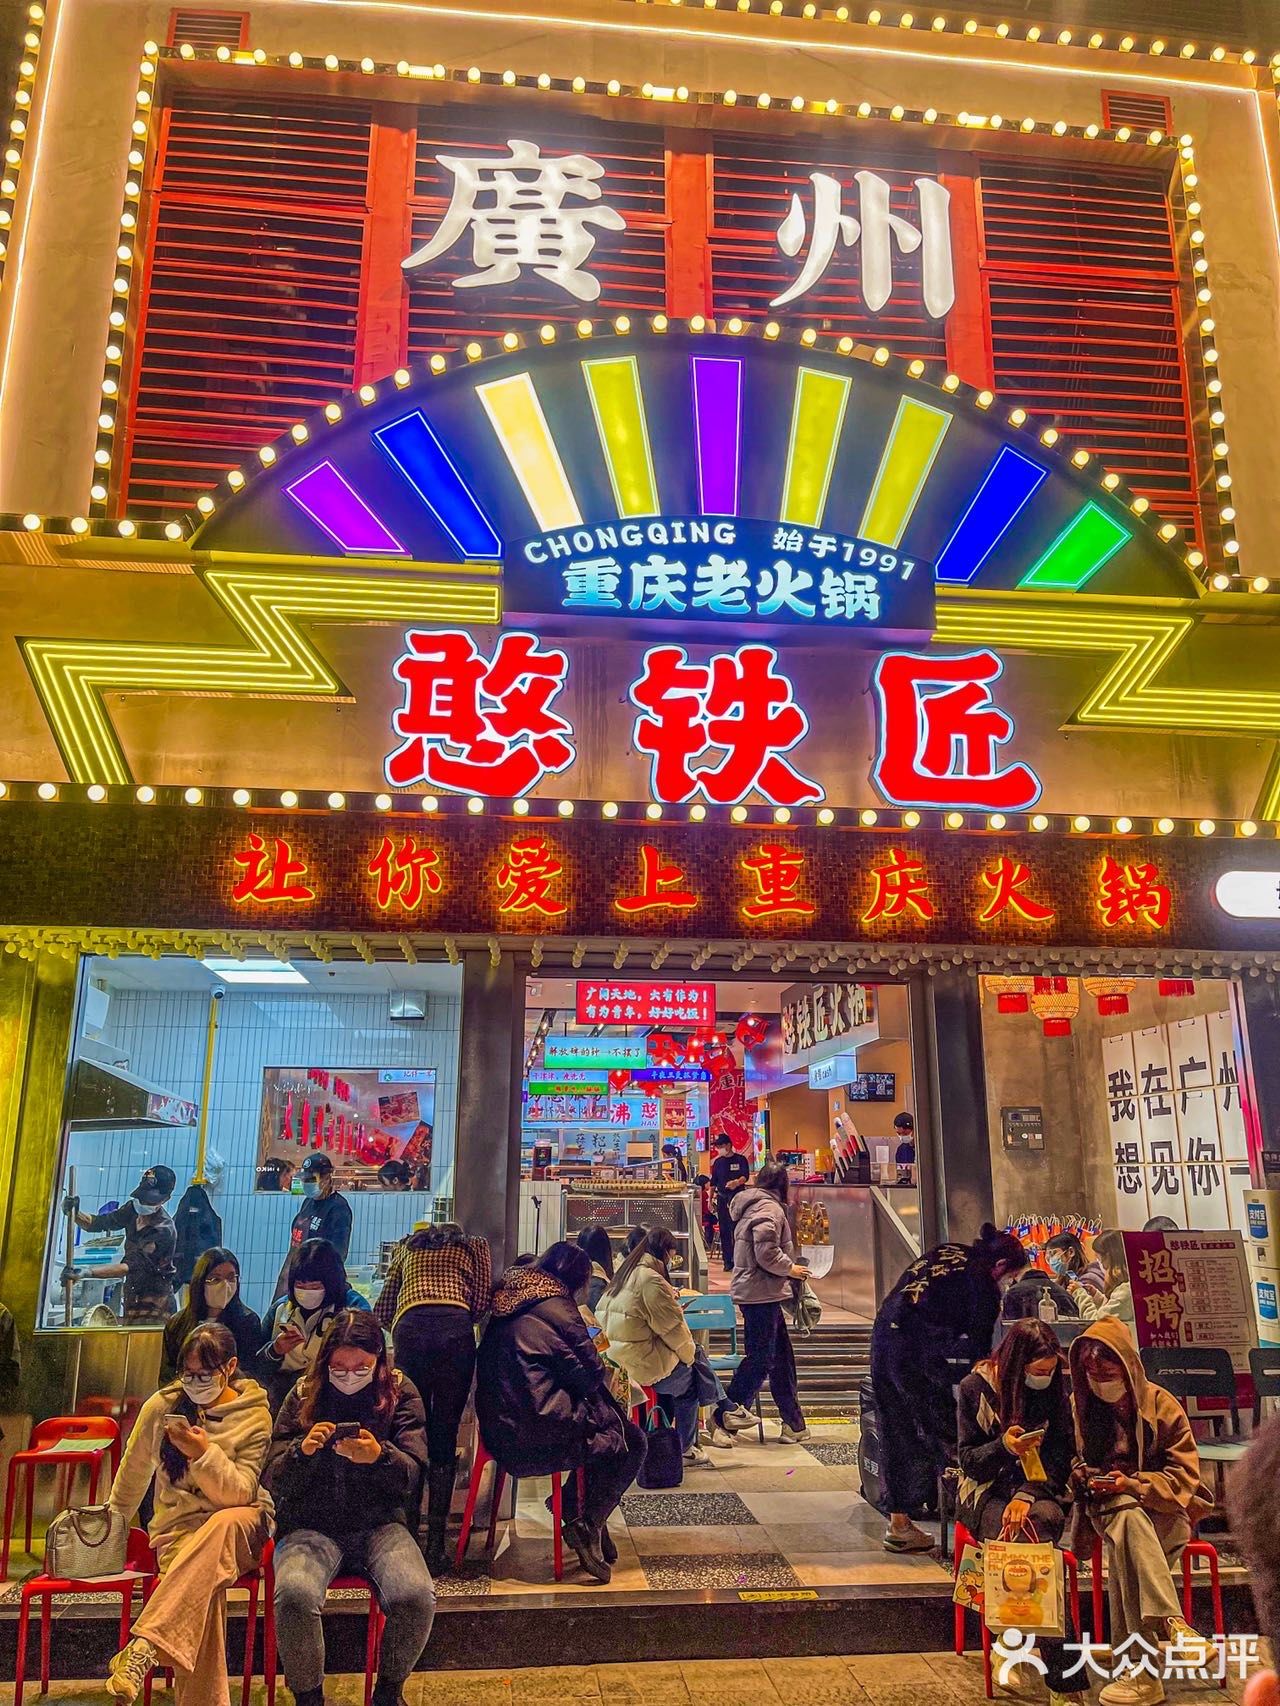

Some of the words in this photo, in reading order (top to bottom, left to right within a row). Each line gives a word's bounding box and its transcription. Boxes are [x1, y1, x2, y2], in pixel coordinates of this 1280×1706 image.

[401, 139, 955, 319] 廣州
[523, 522, 737, 564] CHONGQING
[773, 527, 916, 582] 始于1991
[561, 557, 882, 621] 重庆老火锅
[385, 628, 1041, 812] 憨铁匠
[233, 832, 1172, 930] 让你爱上重庆火锅
[1138, 1249, 1181, 1330] 招聘
